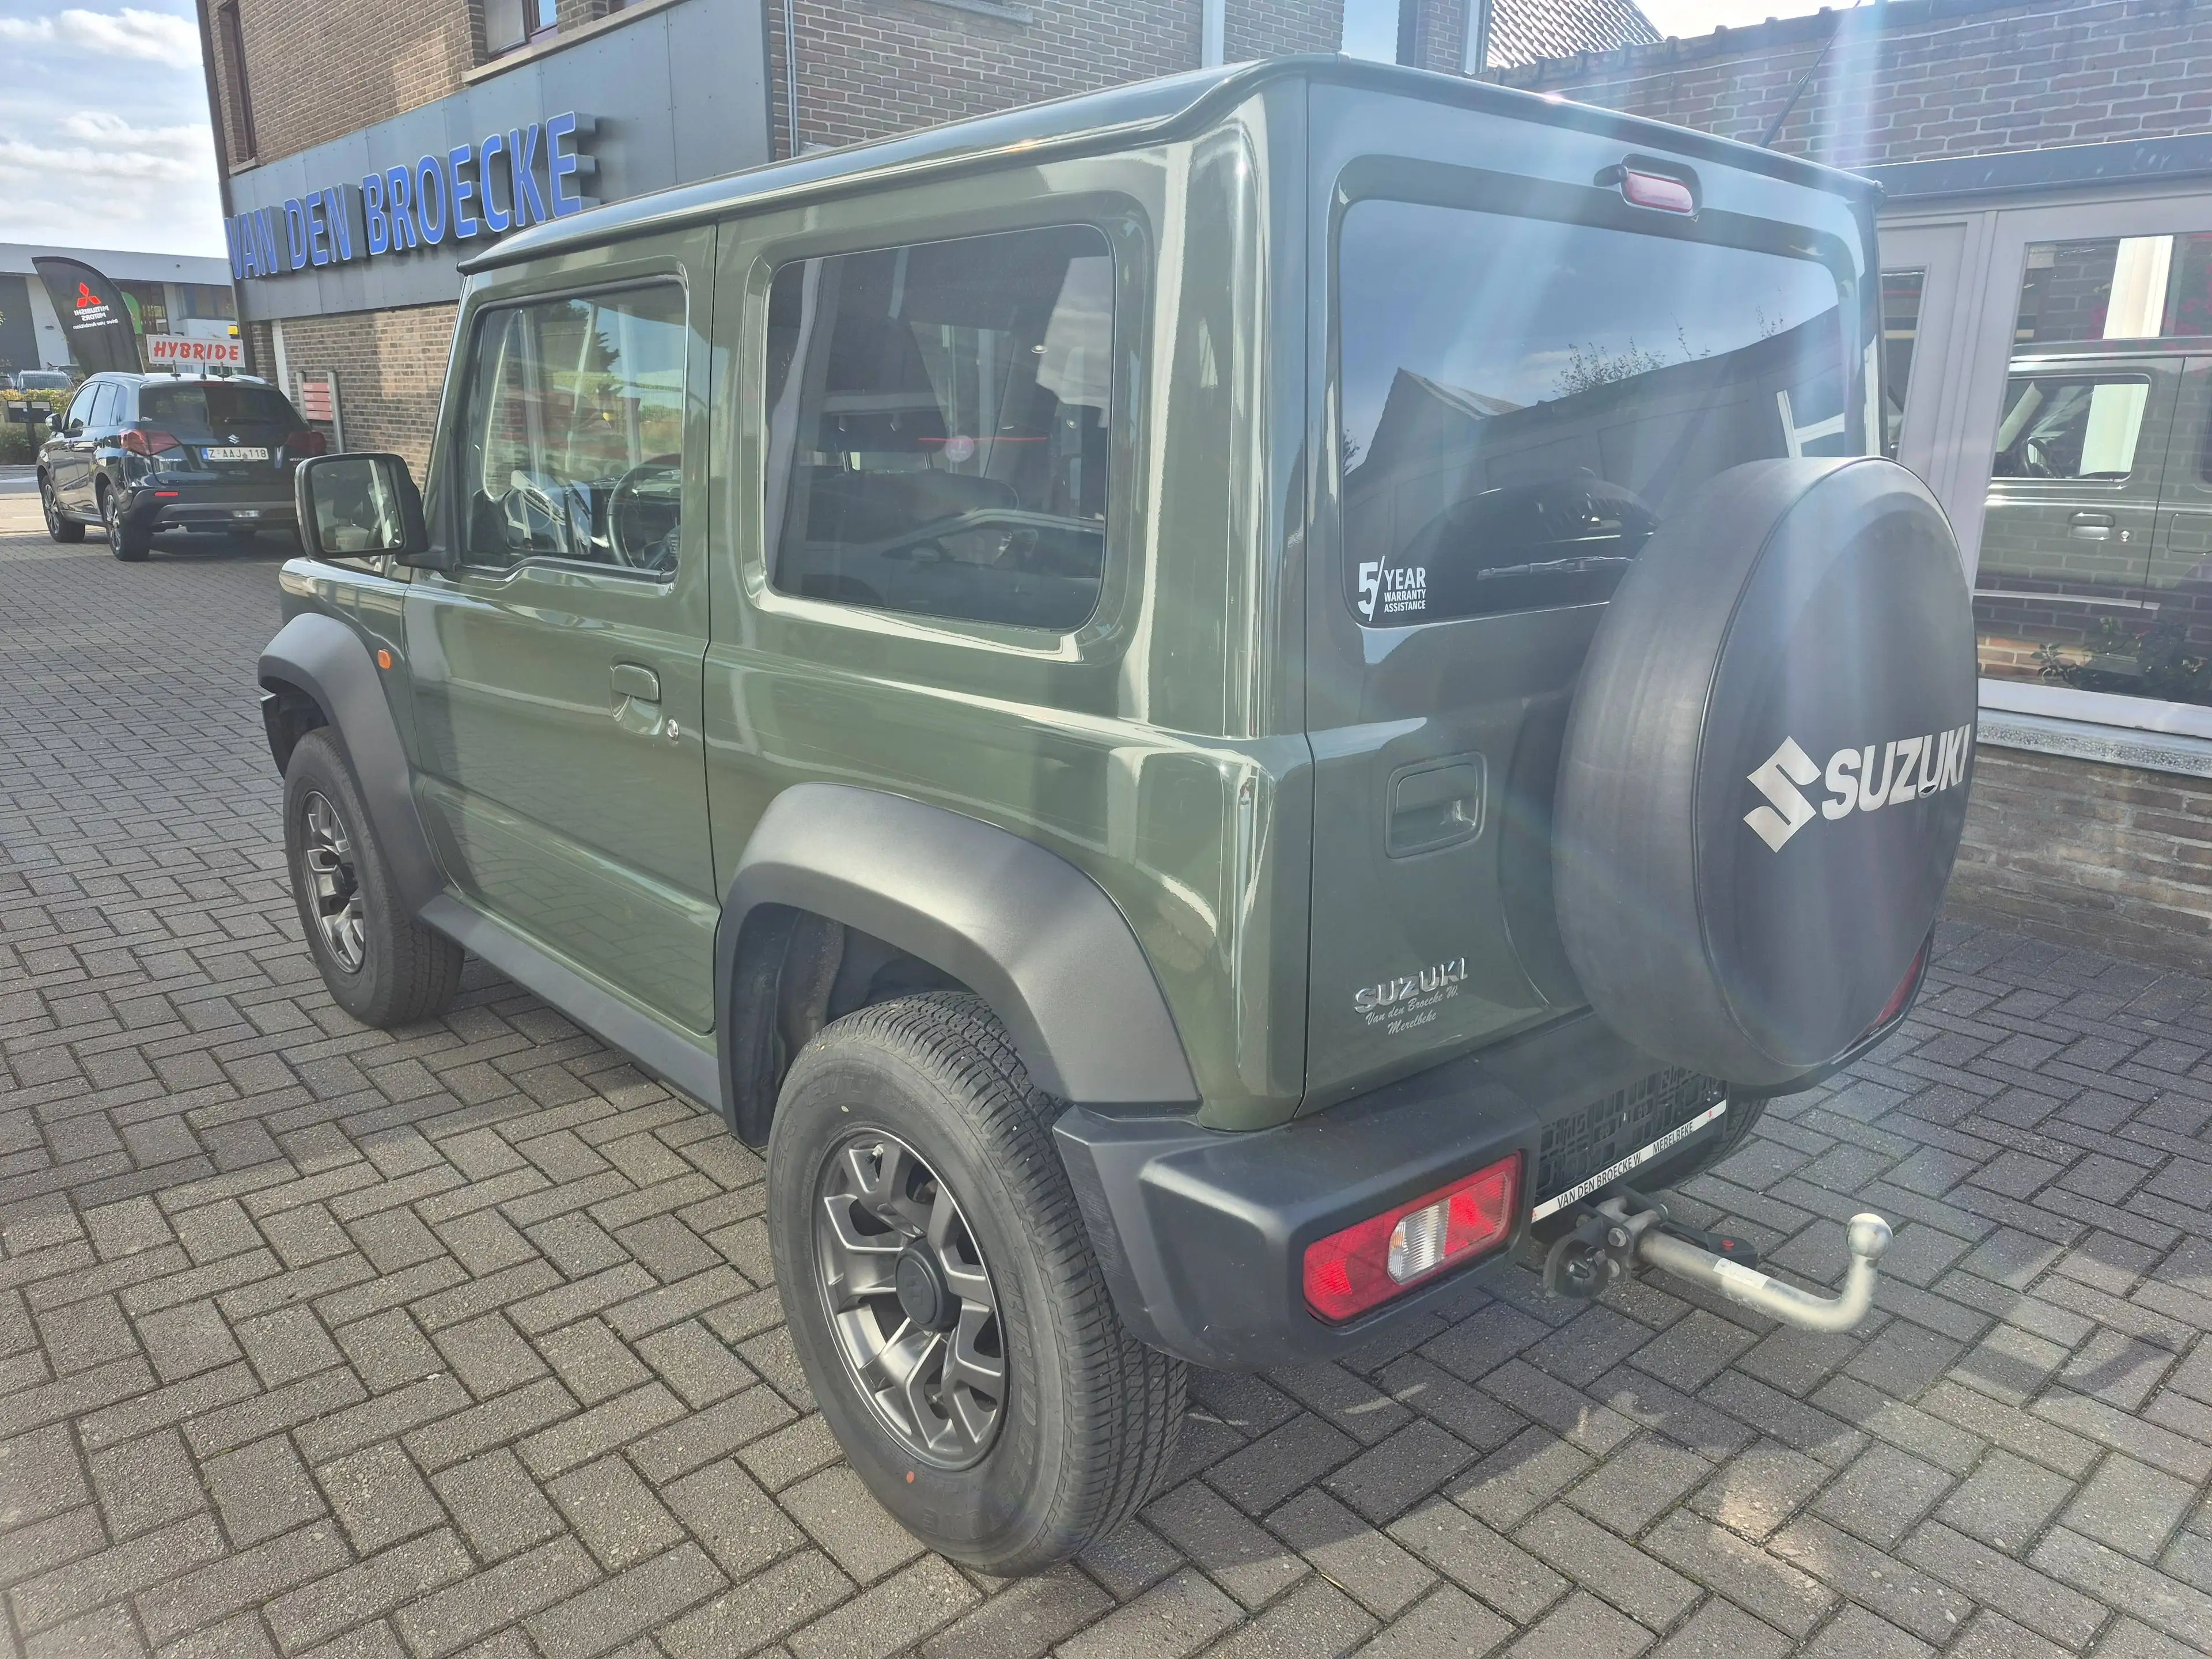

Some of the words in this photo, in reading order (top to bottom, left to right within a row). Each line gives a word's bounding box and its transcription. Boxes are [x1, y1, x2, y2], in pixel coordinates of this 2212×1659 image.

[224, 206, 277, 280] VAN
[284, 183, 351, 270] DEN
[362, 111, 581, 255] BROECKE
[154, 341, 238, 361] HYBRIDE
[1384, 567, 1426, 591] YEAR
[1384, 589, 1426, 603] WARRANTY
[1384, 600, 1426, 613] ASSISTANCE
[1822, 724, 1970, 820] SUZUKI
[1354, 957, 1468, 1013] SUZUKI
[1365, 1011, 1385, 1025] Van
[1388, 1006, 1405, 1018] den
[1407, 991, 1443, 1012] Broecke
[1387, 1009, 1437, 1036] Merelbeke
[1557, 1188, 1575, 1209] VAN
[1577, 1181, 1595, 1199] DEN
[1597, 1157, 1632, 1188] BROECKE
[1653, 1122, 1693, 1155] MERELBEKE
